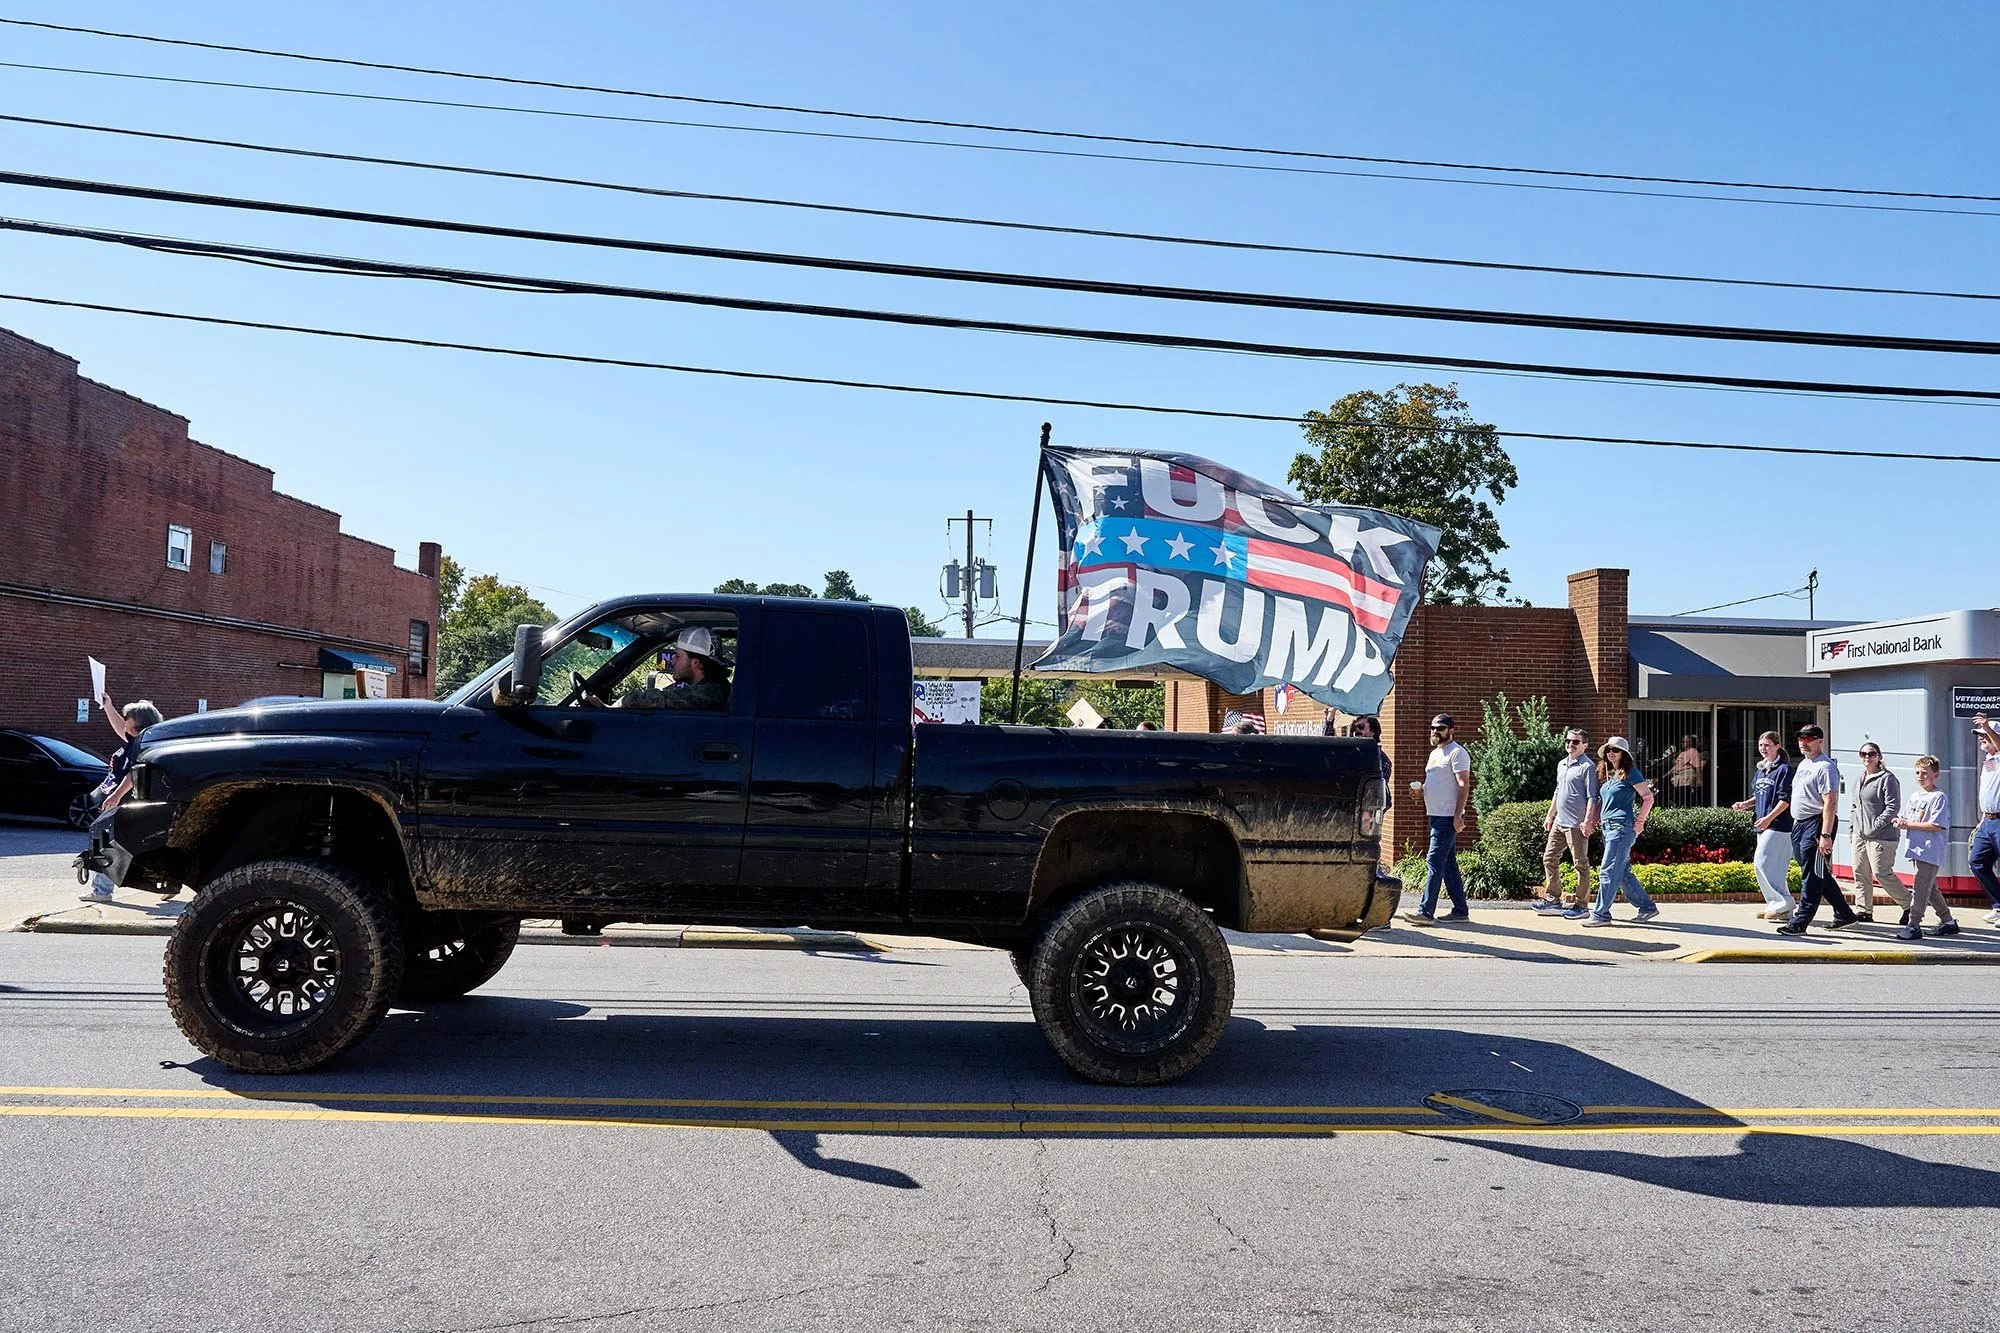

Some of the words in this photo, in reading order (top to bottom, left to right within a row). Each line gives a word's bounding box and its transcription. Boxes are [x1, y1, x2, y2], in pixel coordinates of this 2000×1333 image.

[1068, 458, 1412, 585] FUCK
[1076, 566, 1387, 693] TRUMP
[1847, 644, 1866, 659] First
[1867, 638, 1911, 657] National
[1913, 634, 1943, 652] Bank
[287, 901, 309, 914] FUEL
[1083, 933, 1102, 950] FUEL
